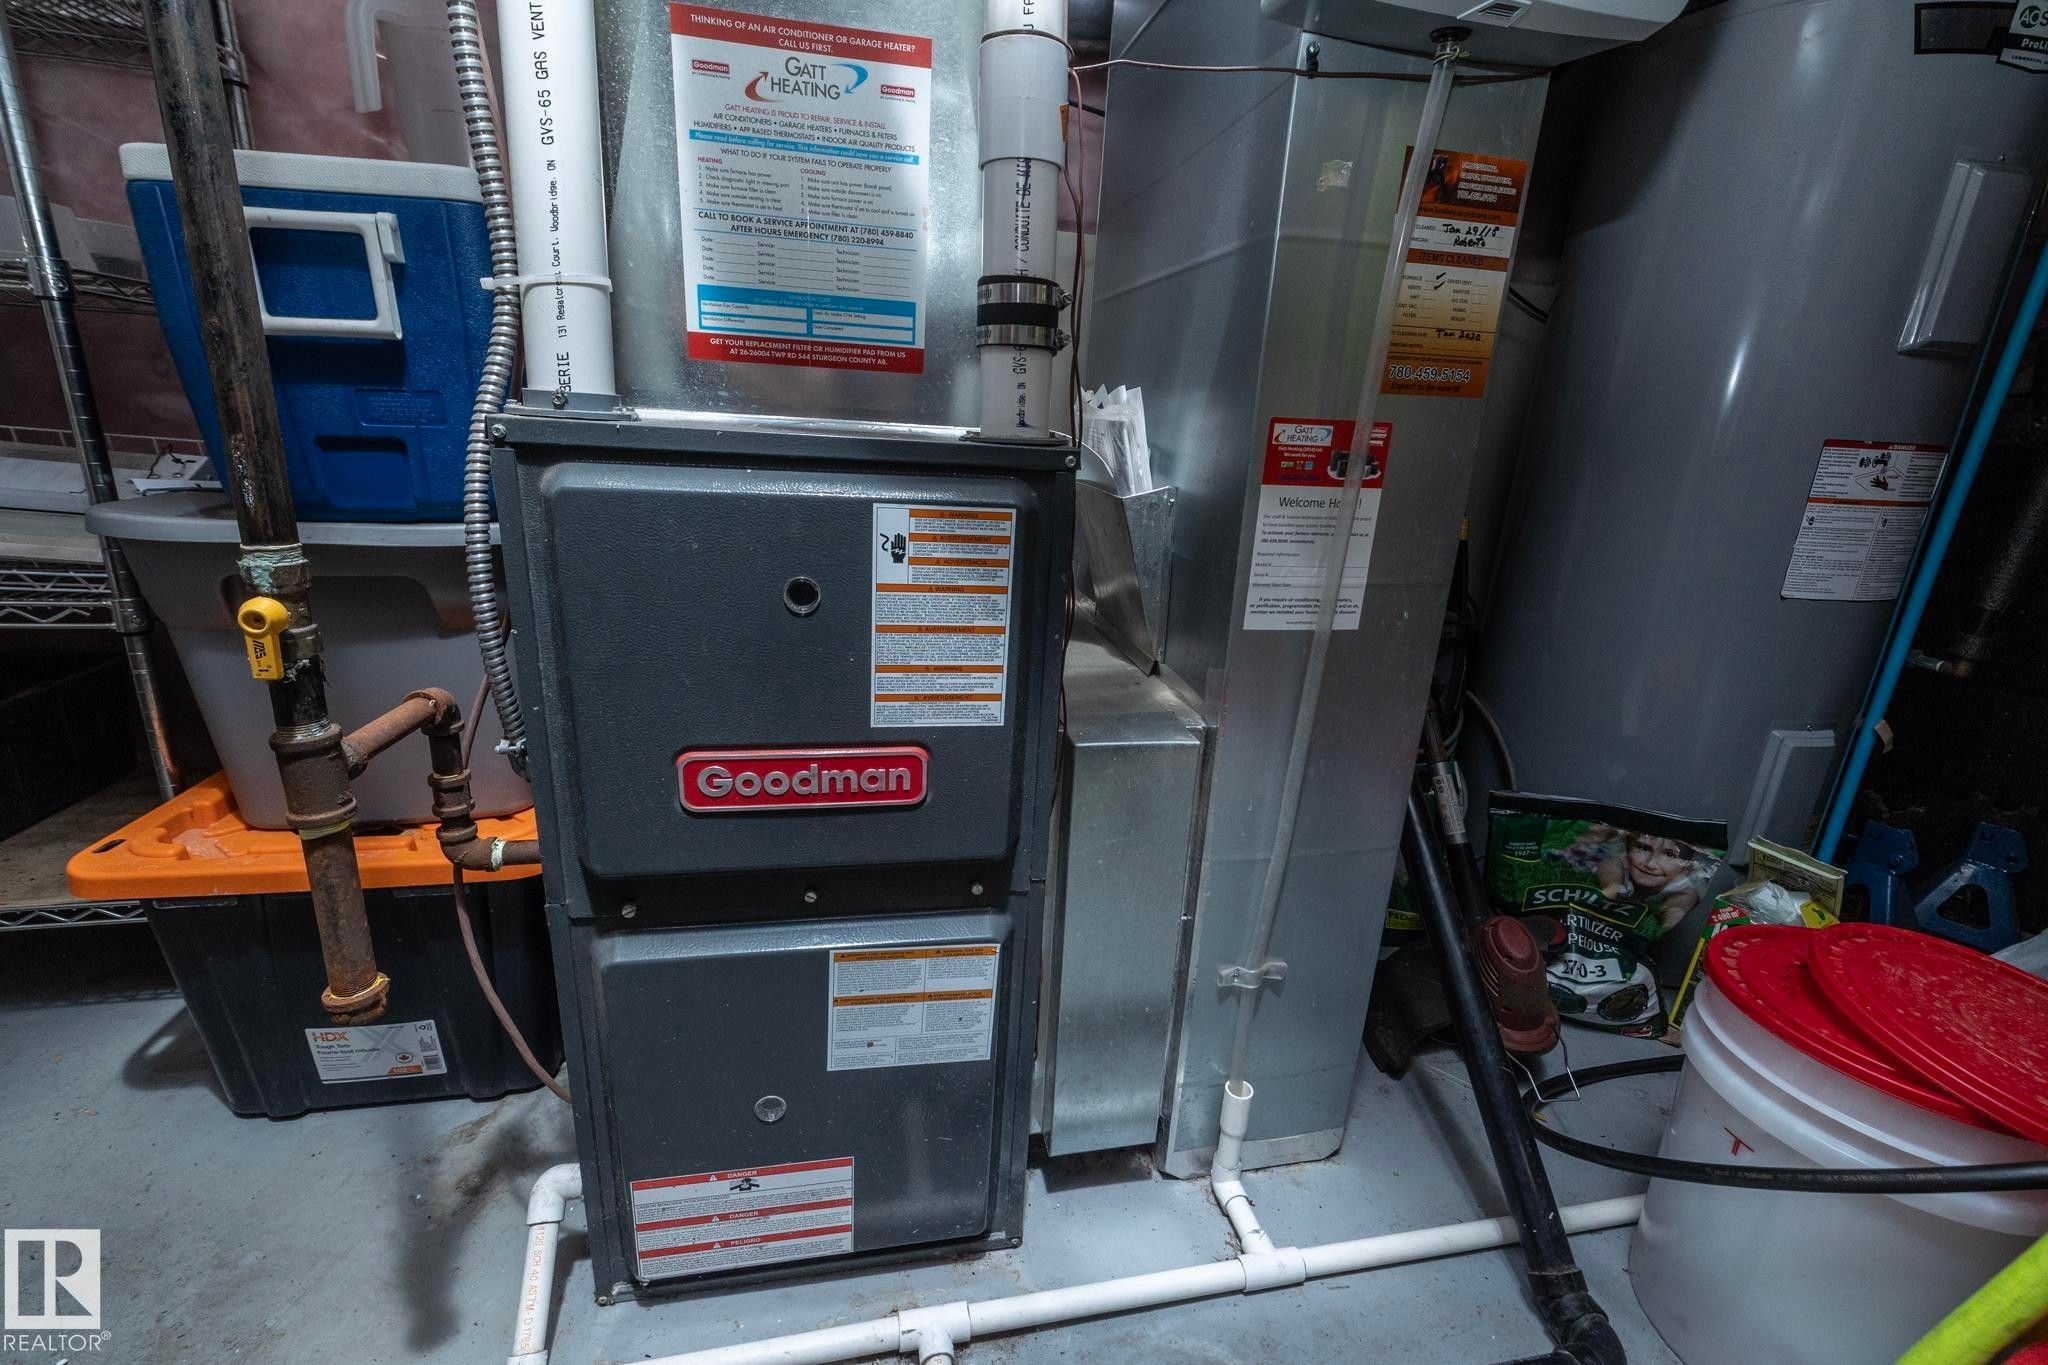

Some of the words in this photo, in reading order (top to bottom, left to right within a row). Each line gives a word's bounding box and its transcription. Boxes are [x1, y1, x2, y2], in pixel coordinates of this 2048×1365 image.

[530, 2, 545, 40] VENT
[689, 13, 732, 28] THINKING
[734, 20, 746, 30] OF
[747, 21, 760, 32] AN
[762, 23, 775, 34] AIR
[778, 26, 833, 42] CONDITIONER
[835, 34, 847, 44] OR
[849, 36, 881, 48] GARAGE
[883, 40, 915, 53] HEATER?
[778, 38, 796, 48] CALL
[799, 40, 809, 49] US
[811, 42, 832, 53] FIRST.
[534, 51, 549, 80] GAS
[692, 61, 728, 72] Goodman
[784, 55, 826, 80] GATT
[770, 76, 840, 100] HEATING
[881, 85, 914, 96] Goodman
[538, 89, 554, 145] GVS-65
[724, 103, 740, 111] GATT
[742, 105, 769, 115] HEATING
[778, 109, 798, 118] PROUD
[833, 116, 856, 125] SERVICE
[864, 120, 885, 128] INSTALL
[712, 112, 723, 120] AIR
[724, 113, 771, 126] CONDITIONERS
[779, 120, 805, 129] GARAGE
[807, 123, 831, 133] HEATERS
[838, 127, 869, 137] FURNACES
[877, 131, 897, 140] FILTERS
[694, 120, 731, 131] HUMIDIFIERS
[739, 125, 749, 133] APP
[752, 127, 771, 135] BASED
[773, 129, 814, 140] THERMOSTATS
[821, 135, 846, 144] INDOOR
[859, 139, 882, 148] QUALITY
[884, 142, 915, 152] PRODUCTS
[547, 159, 556, 171] ON
[697, 156, 722, 164] HEATING
[720, 148, 738, 156] WHAT
[768, 153, 786, 161] YOUR
[787, 155, 810, 163] SYSTEM
[837, 161, 862, 169] OPERATE
[864, 164, 891, 172] PROPERLY
[1016, 180, 1032, 197] DE
[698, 211, 716, 220] CALL
[718, 213, 728, 221] TO
[730, 214, 753, 223] BOOK
[755, 216, 761, 224] A
[763, 217, 792, 227] SERVICE
[794, 220, 848, 232] APPOINTMENT
[849, 225, 858, 234] AT
[860, 227, 878, 235] (780)
[880, 228, 913, 239] 459-8840
[1014, 198, 1031, 252] CONDUITE
[1441, 221, 1461, 234] Jan
[730, 224, 752, 233] AFTER
[755, 226, 781, 236] HOURS
[783, 229, 828, 240] EMERGENCY
[831, 234, 849, 242] (780)
[851, 236, 883, 245] 220-8994
[1418, 252, 1445, 263] ITEMS
[1445, 254, 1484, 266] CLEANED
[555, 270, 567, 320] Regalcret
[558, 325, 567, 338] 131
[1434, 328, 1456, 339] Jan
[745, 340, 790, 349] REPLACEMENT
[792, 343, 811, 351] FILTER
[824, 346, 861, 354] HUMIDIFIER
[812, 354, 846, 362] STURGEON
[1387, 364, 1472, 383] 780.459.5154
[1017, 382, 1026, 390] ON
[1294, 425, 1313, 434] GATT
[1286, 434, 1318, 443] HEATING
[1278, 497, 1326, 508] Welcome
[939, 534, 991, 543] AVERTISSEMENT
[696, 763, 911, 798] Goodman
[312, 1030, 350, 1042] HDX
[727, 1170, 756, 1178] DANGER
[729, 1210, 758, 1219] DANGER
[730, 1237, 760, 1246] PELIGRO
[532, 1250, 542, 1266] SCH
[530, 1270, 538, 1280] 40
